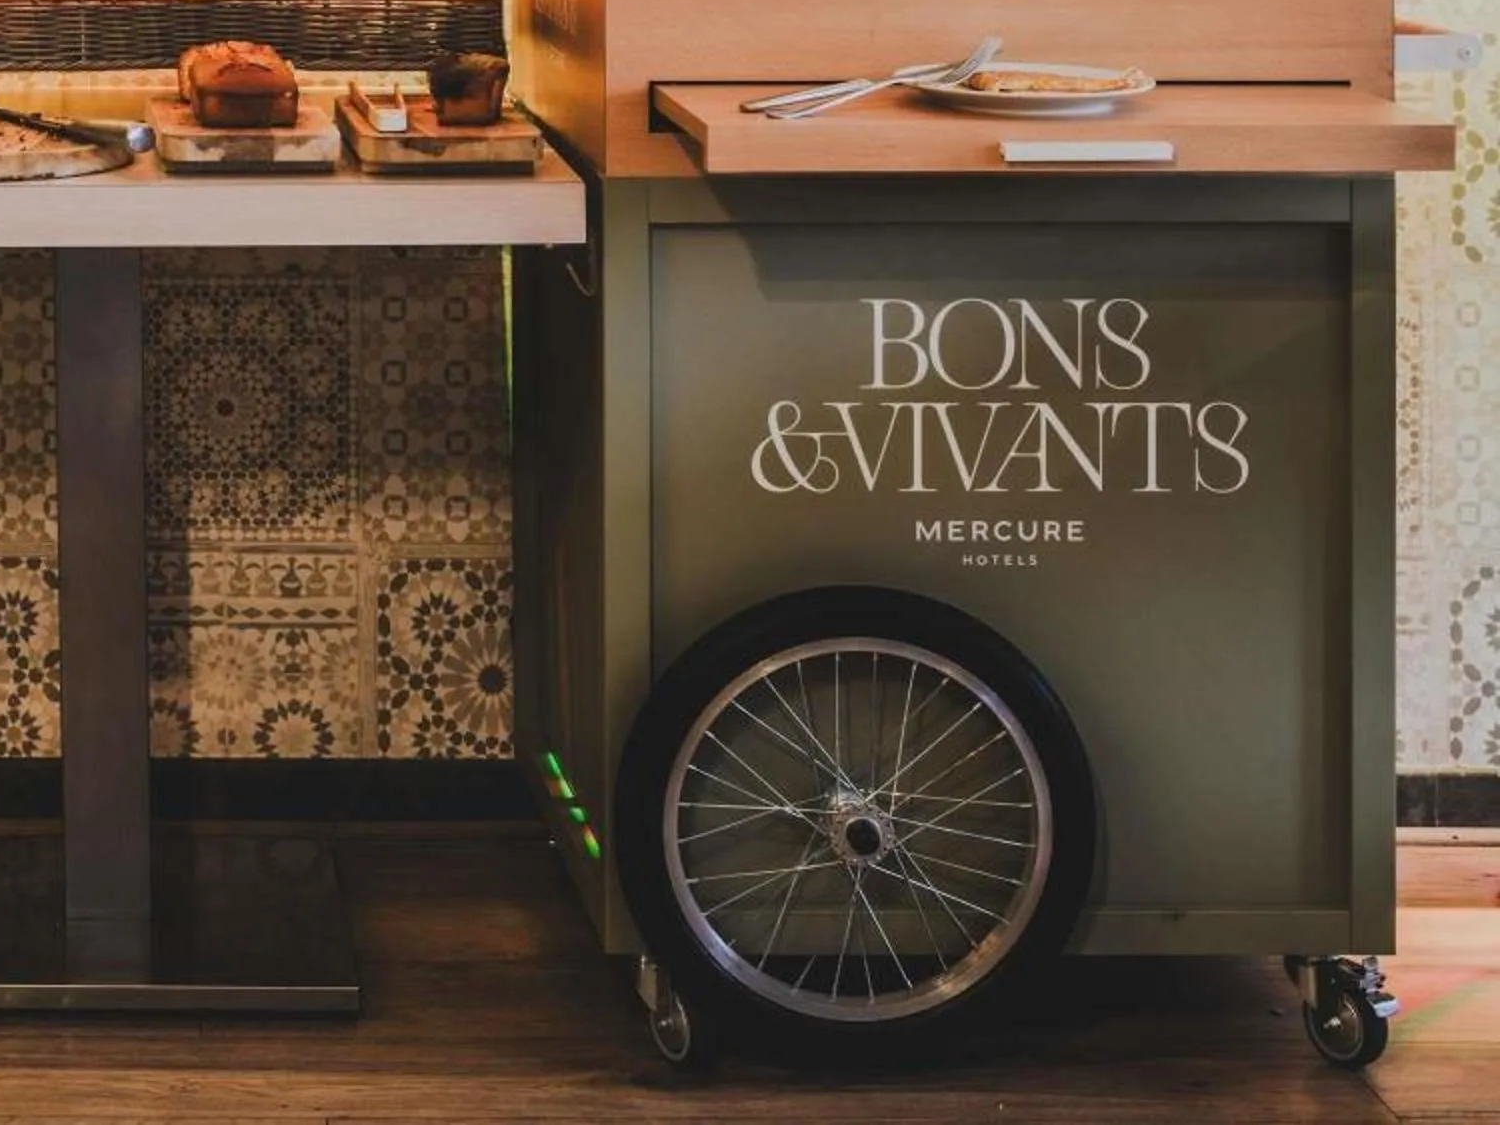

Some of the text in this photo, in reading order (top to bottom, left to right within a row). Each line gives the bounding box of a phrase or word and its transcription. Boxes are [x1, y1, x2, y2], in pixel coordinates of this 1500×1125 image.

[860, 298, 1151, 390] BONS
[915, 520, 1085, 541] MERCURE
[963, 554, 1038, 566] HOTELS
